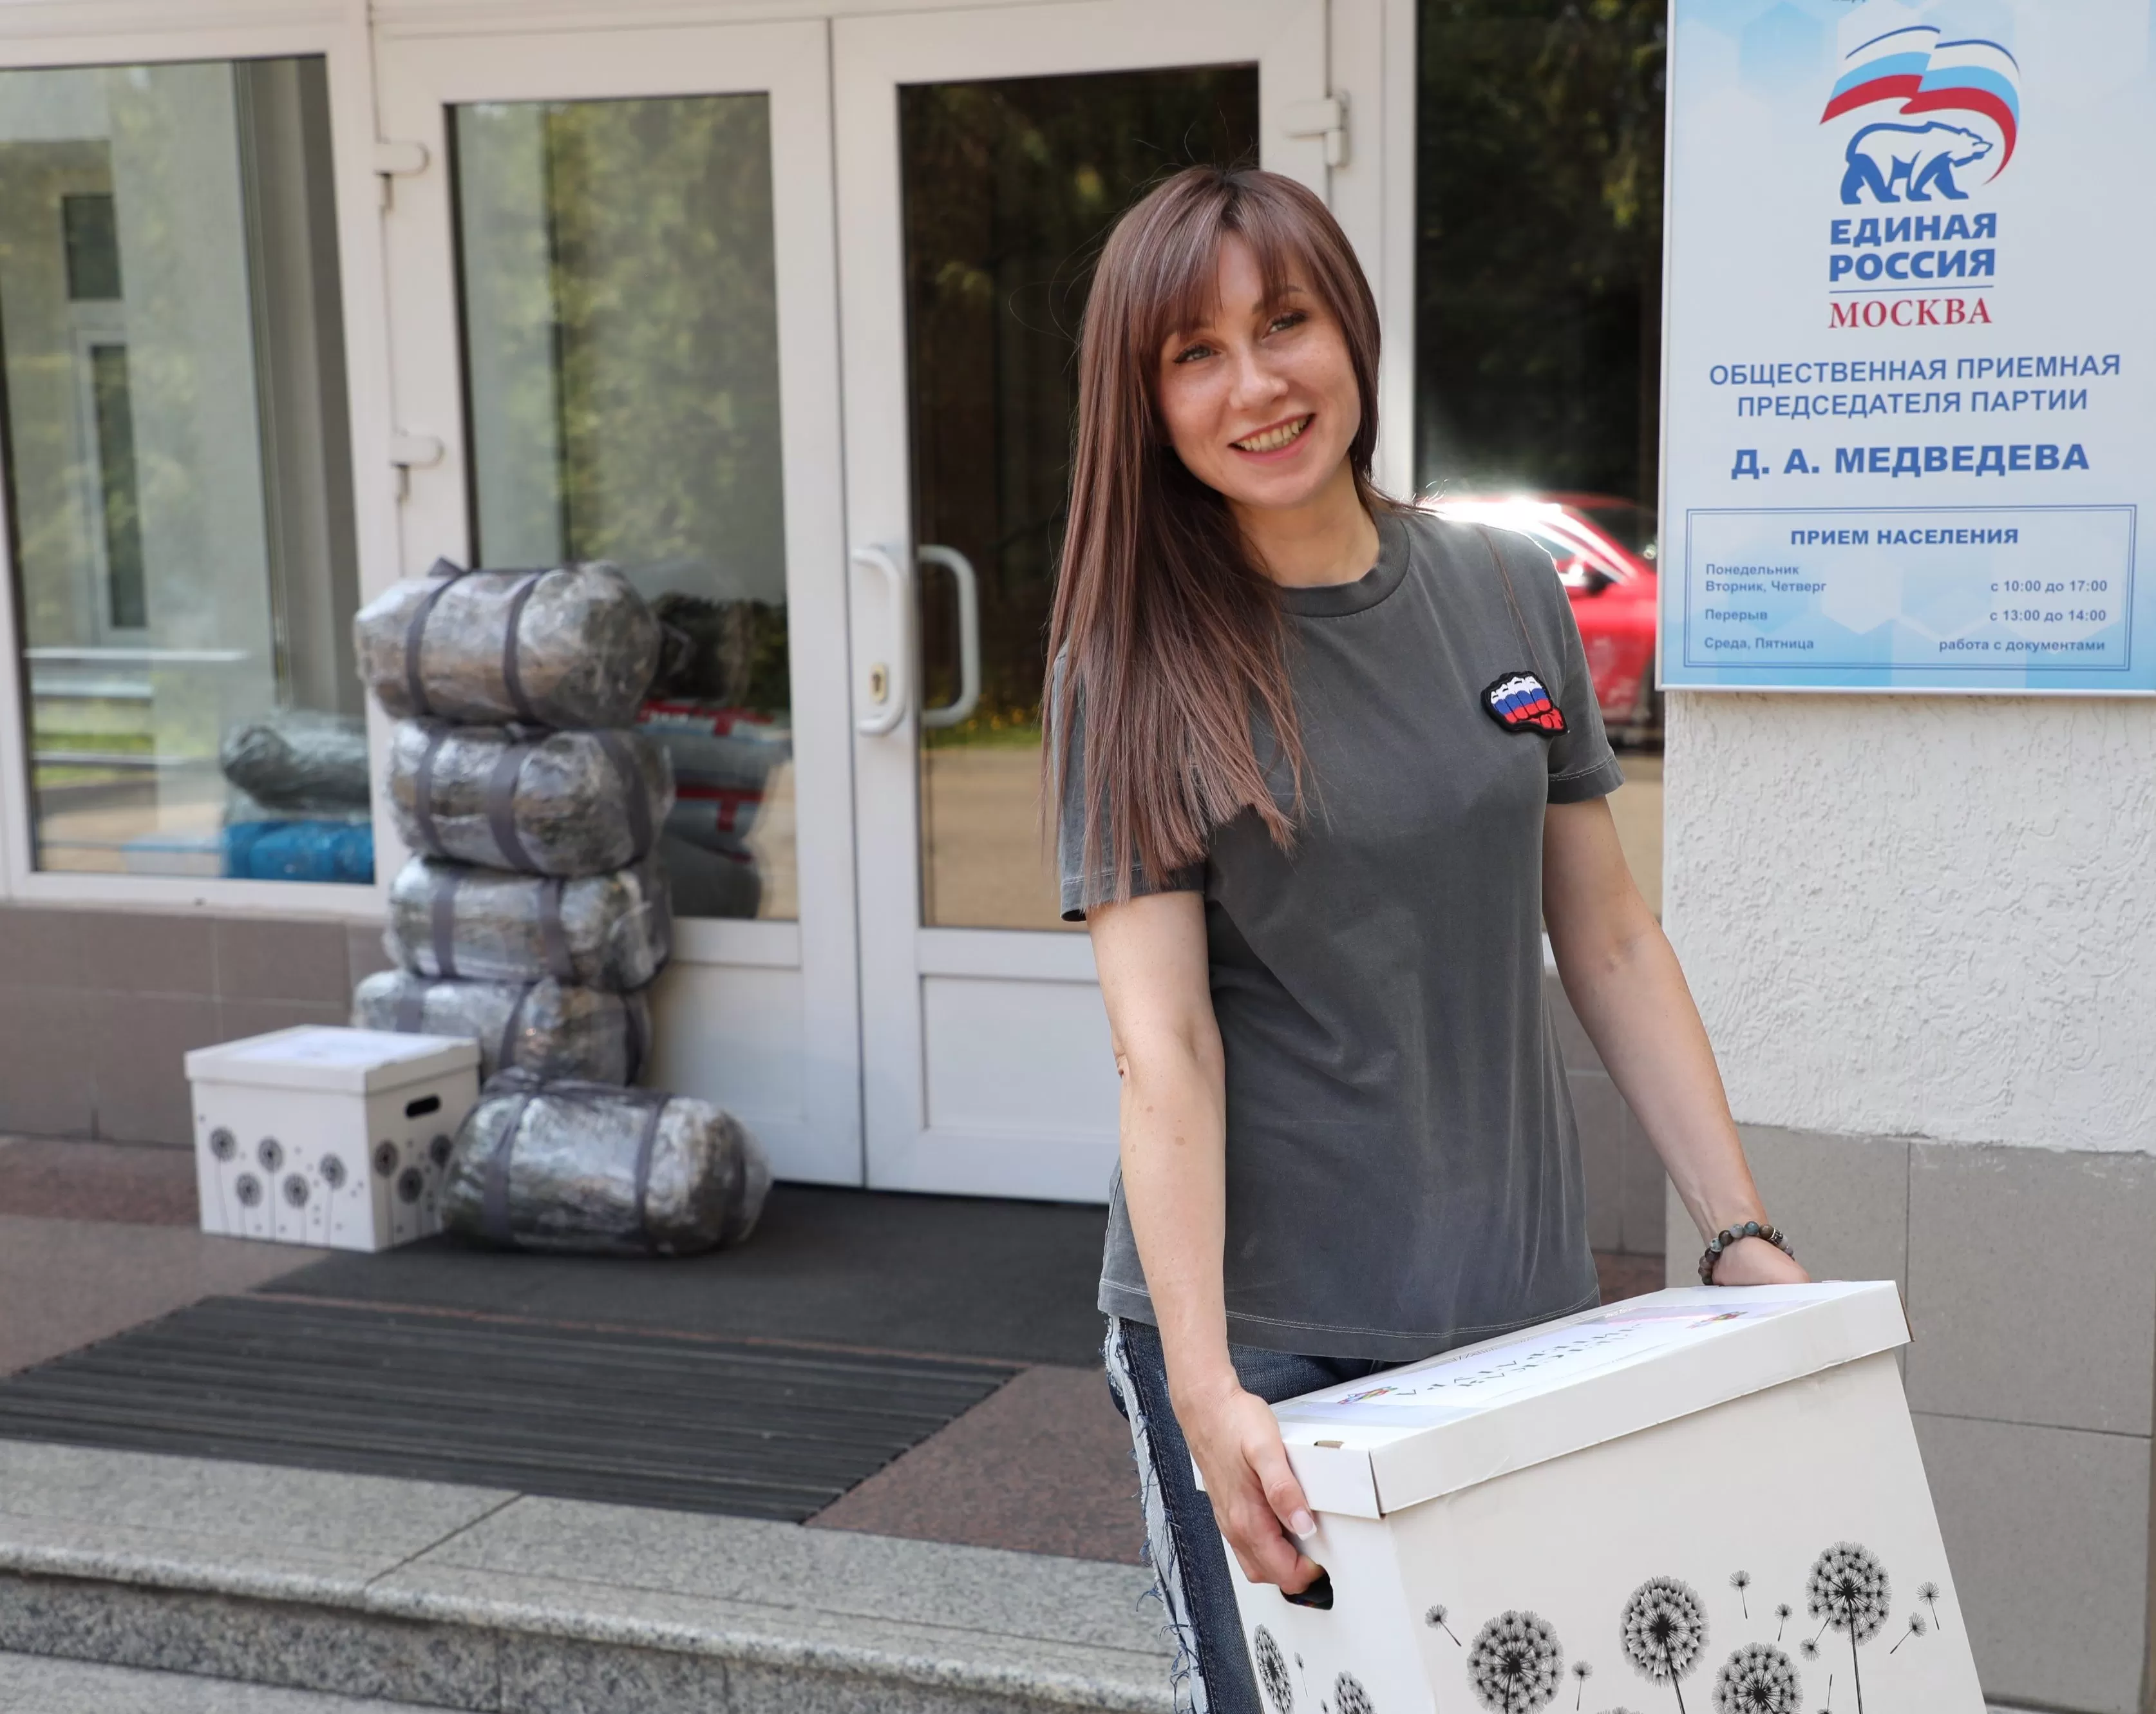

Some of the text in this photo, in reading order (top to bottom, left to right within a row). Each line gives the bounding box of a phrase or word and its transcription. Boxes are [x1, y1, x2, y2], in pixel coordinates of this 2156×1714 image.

[1830, 212, 1997, 247] ЕДИНАЯ
[1829, 246, 1995, 282] РОССИЯ
[1829, 298, 1992, 329] МОСКВА
[1710, 354, 2120, 388] ОБЩЕСТВЕННАЯ ПРИЕМНАЯ
[1738, 388, 2087, 420] ПРЕДСЕДАТЕЛЯ ПАРТИИ
[1731, 443, 2090, 480] Д. А. МЕДВЕДЕВА
[1791, 529, 2019, 546] ПРИЕМ НАСЕЛЕНИЯ
[1706, 563, 1799, 576] Понедельник
[1705, 580, 1827, 595] Вторник, Четверг
[2004, 580, 2041, 592] 10:00
[2045, 582, 2065, 593] до
[2070, 580, 2108, 592] 17:00
[1705, 608, 1768, 623] Перерыв
[2003, 609, 2040, 622] 13:00
[2043, 612, 2063, 623] до
[2068, 609, 2106, 622] 14:00
[1704, 636, 1814, 651] Среда, Пятница
[1939, 638, 1989, 653] работа
[2005, 640, 2105, 655] документами
